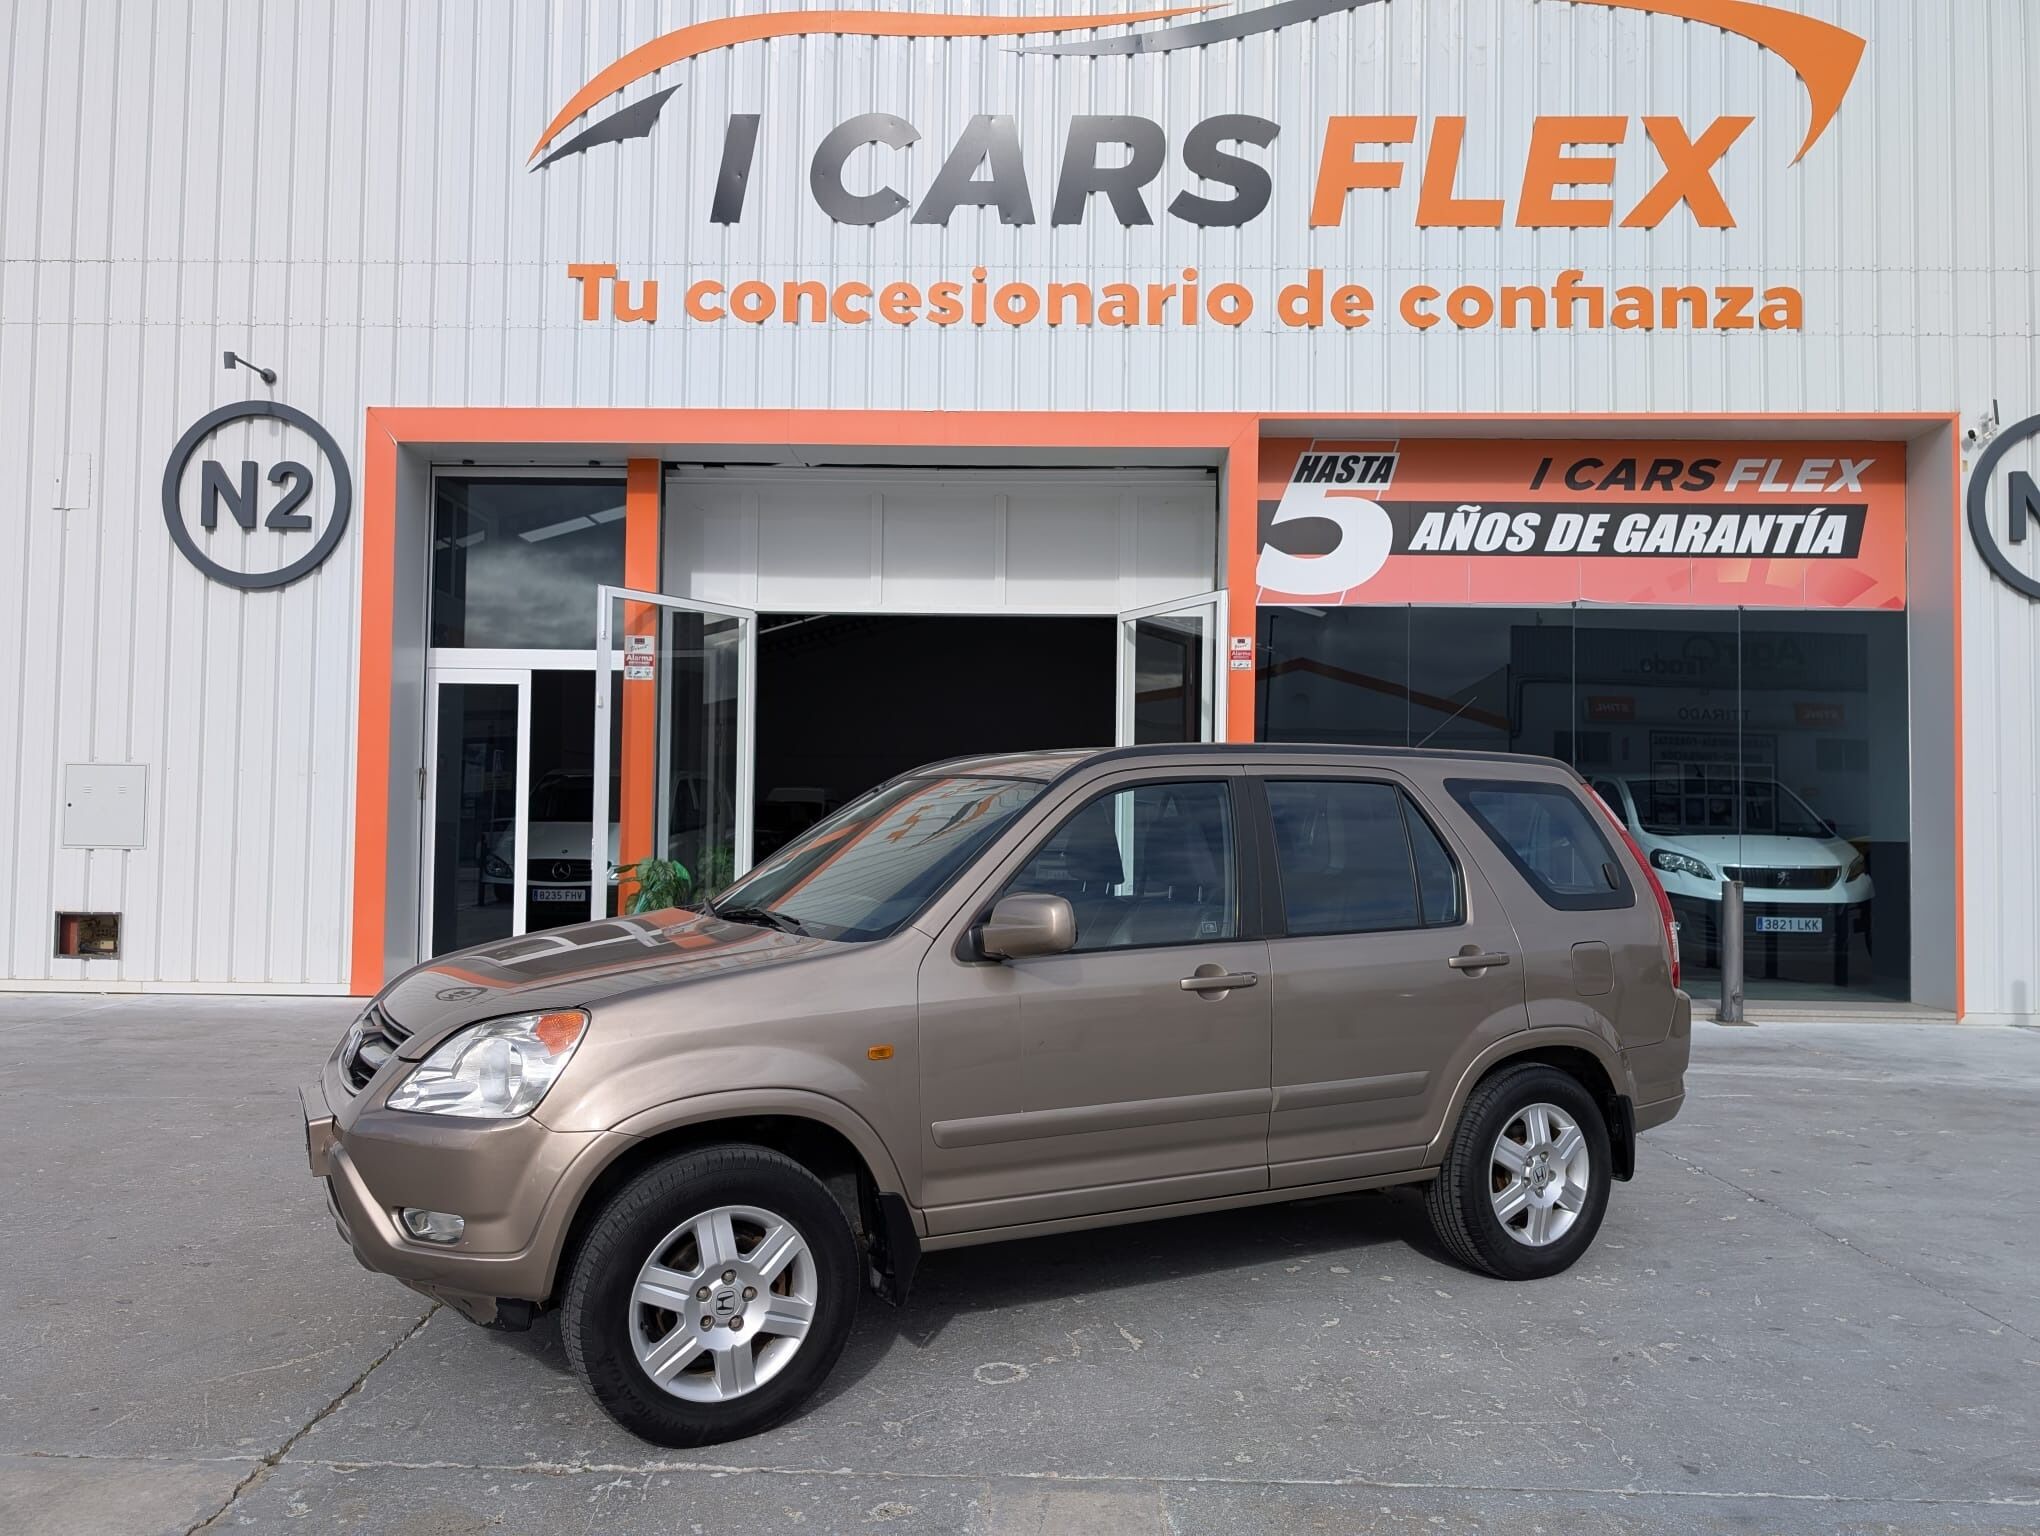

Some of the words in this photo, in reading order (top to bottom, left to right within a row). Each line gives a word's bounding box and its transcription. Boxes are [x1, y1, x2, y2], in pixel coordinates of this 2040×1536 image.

[710, 113, 760, 223] I
[810, 113, 1281, 226] CARS
[1310, 116, 1756, 228] FLEX
[567, 264, 658, 323] Tu
[684, 267, 1254, 326] concesionario
[1277, 269, 1374, 328] de
[1400, 270, 1802, 330] confianza
[1293, 455, 1396, 484] HASTA
[1529, 457, 1553, 490] I
[1564, 457, 1721, 492] CARS
[1723, 458, 1876, 493] FLEX
[200, 461, 313, 530] N2
[1256, 452, 1400, 595] 5
[1408, 504, 1542, 552] AÑOS
[1544, 513, 1611, 553] DE
[1613, 507, 1848, 554] GARANTÍA
[539, 890, 562, 900] 8235
[565, 890, 583, 900] FHV
[1765, 919, 1792, 930] 3821
[1798, 919, 1819, 931] LKK
